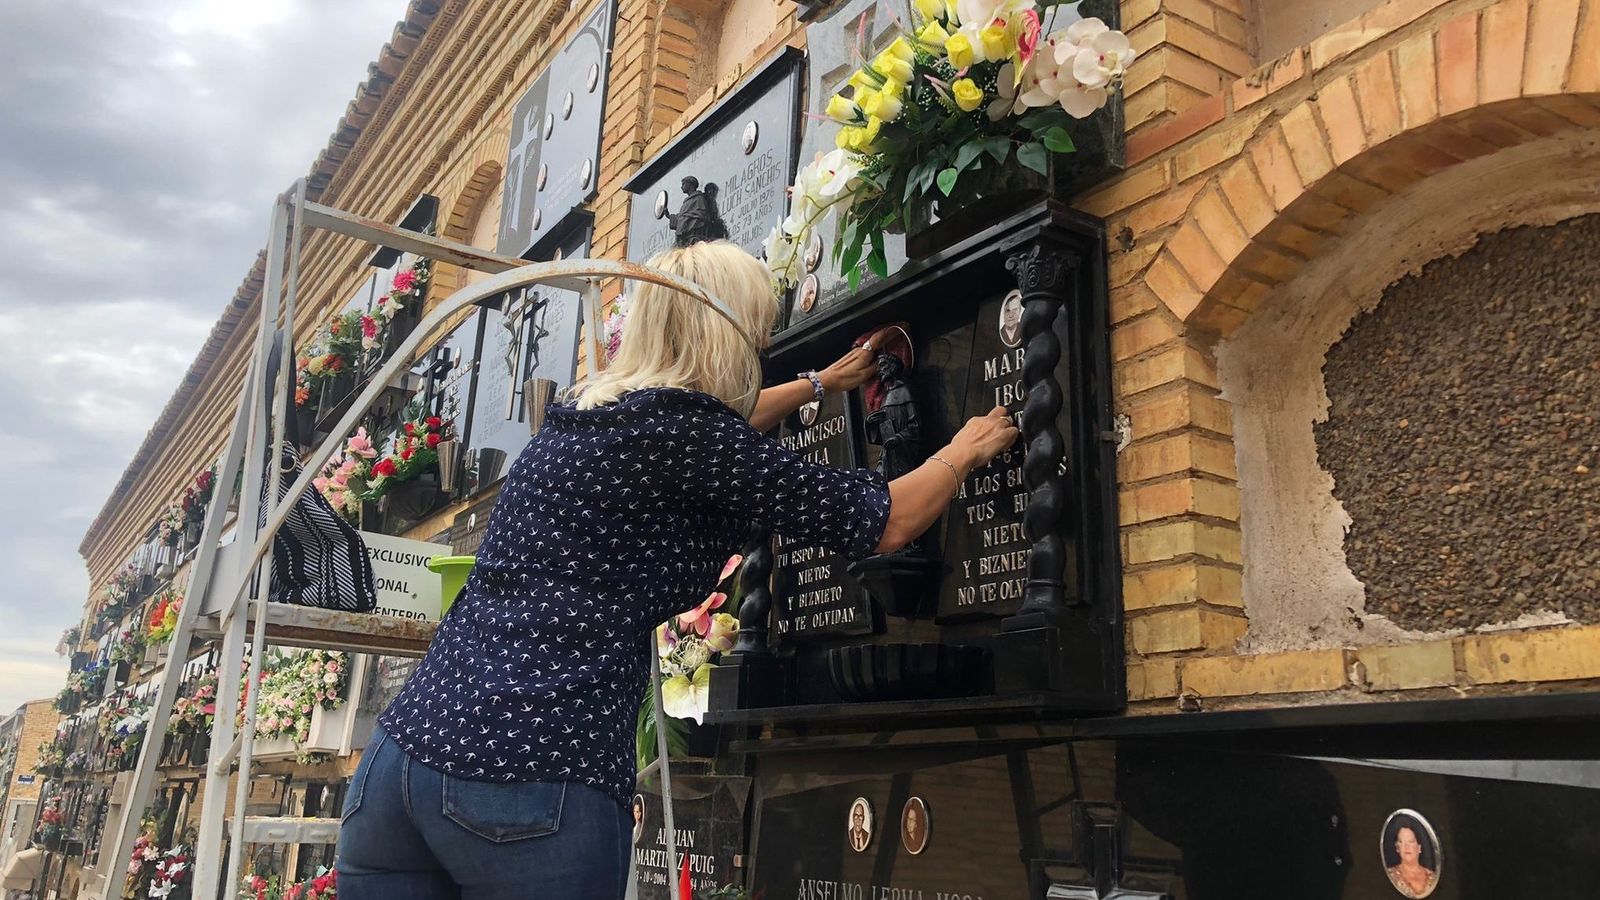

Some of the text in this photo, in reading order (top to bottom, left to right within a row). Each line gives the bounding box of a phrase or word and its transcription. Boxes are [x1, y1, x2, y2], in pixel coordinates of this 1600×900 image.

[725, 148, 773, 197] MILAGROS
[720, 161, 781, 217] LUCH SANCHIS
[780, 415, 845, 452] FRANCISCO
[974, 473, 1001, 496] LOS
[967, 500, 996, 525] TUS
[983, 522, 1027, 548] NIET
[777, 553, 788, 568] TU
[791, 546, 814, 565] ESPO
[962, 559, 972, 579] Y
[376, 577, 410, 594] ONAL
[798, 564, 831, 586] NIETOS
[787, 585, 843, 611] Y BIZNIETO
[957, 586, 976, 606] NO
[979, 582, 997, 603] TE
[777, 606, 856, 634] NO TE OLVIDAN
[689, 853, 715, 875] PUIG
